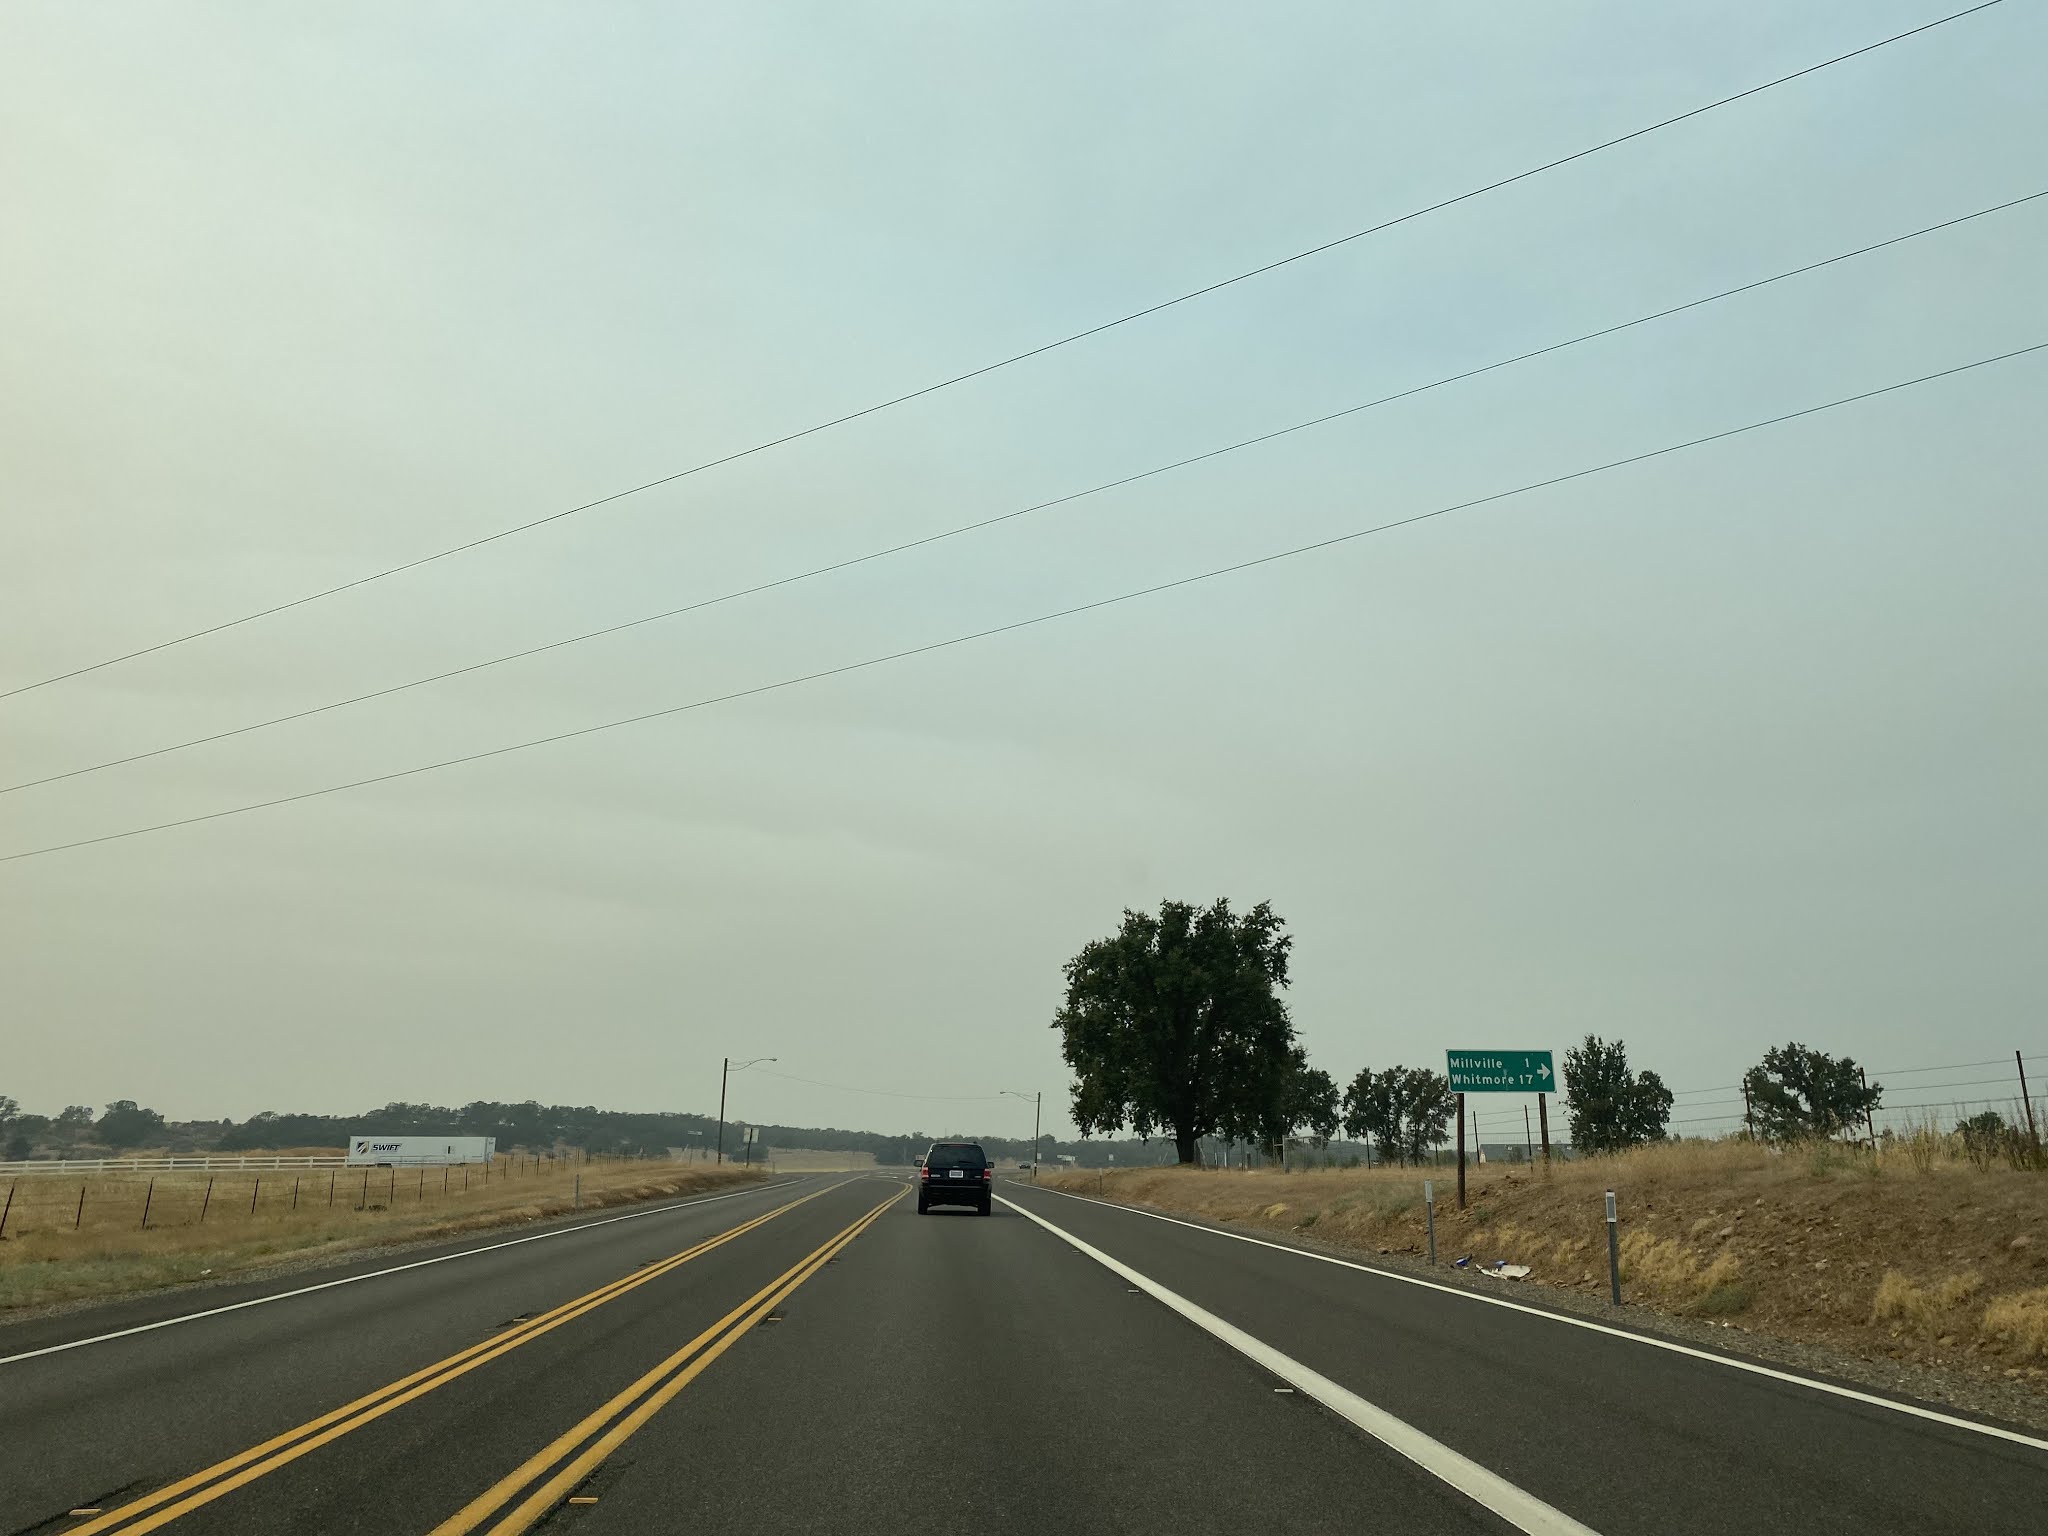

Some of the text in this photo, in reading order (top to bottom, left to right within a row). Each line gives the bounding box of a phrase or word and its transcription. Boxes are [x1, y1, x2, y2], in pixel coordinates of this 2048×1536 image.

[1450, 1057, 1530, 1069] Millville 1
[1451, 1074, 1534, 1085] Whitmore 17
